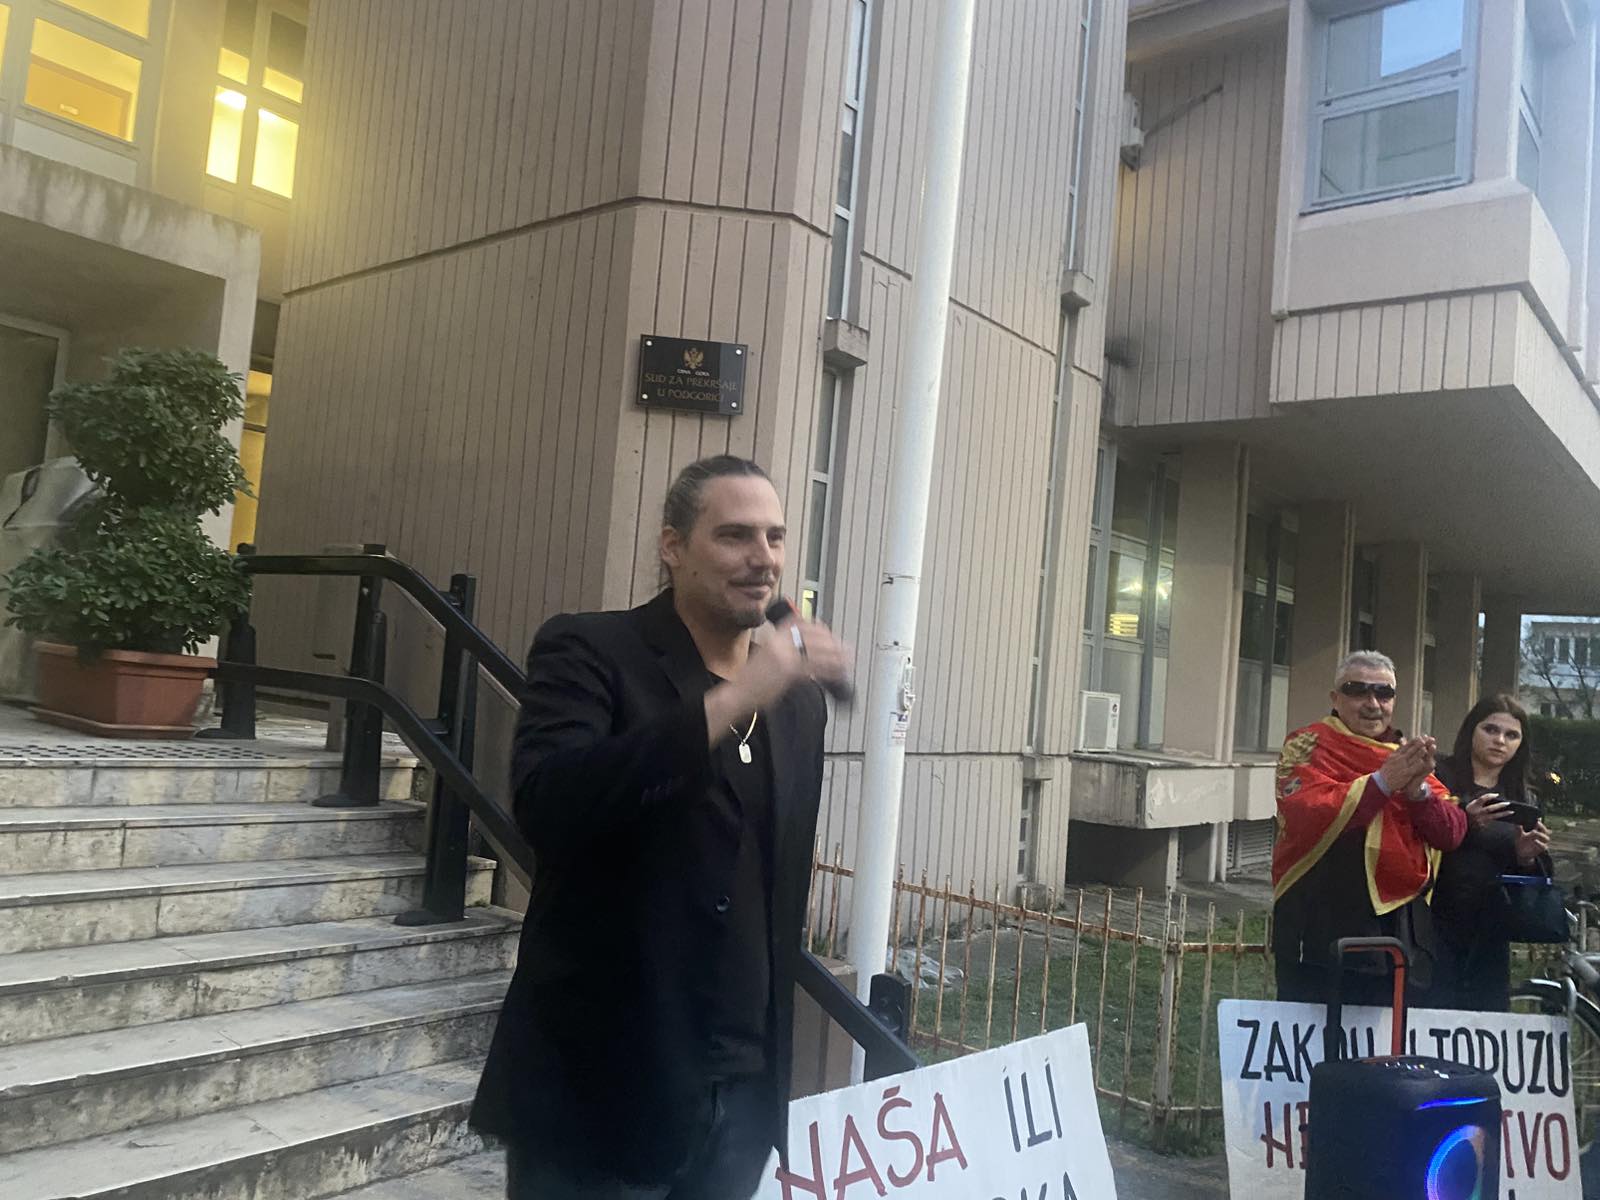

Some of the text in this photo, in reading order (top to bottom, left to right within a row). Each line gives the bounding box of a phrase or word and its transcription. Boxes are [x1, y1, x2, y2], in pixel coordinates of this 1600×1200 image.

[645, 373, 666, 383] SUD
[668, 375, 684, 386] ZA
[657, 388, 665, 397] U
